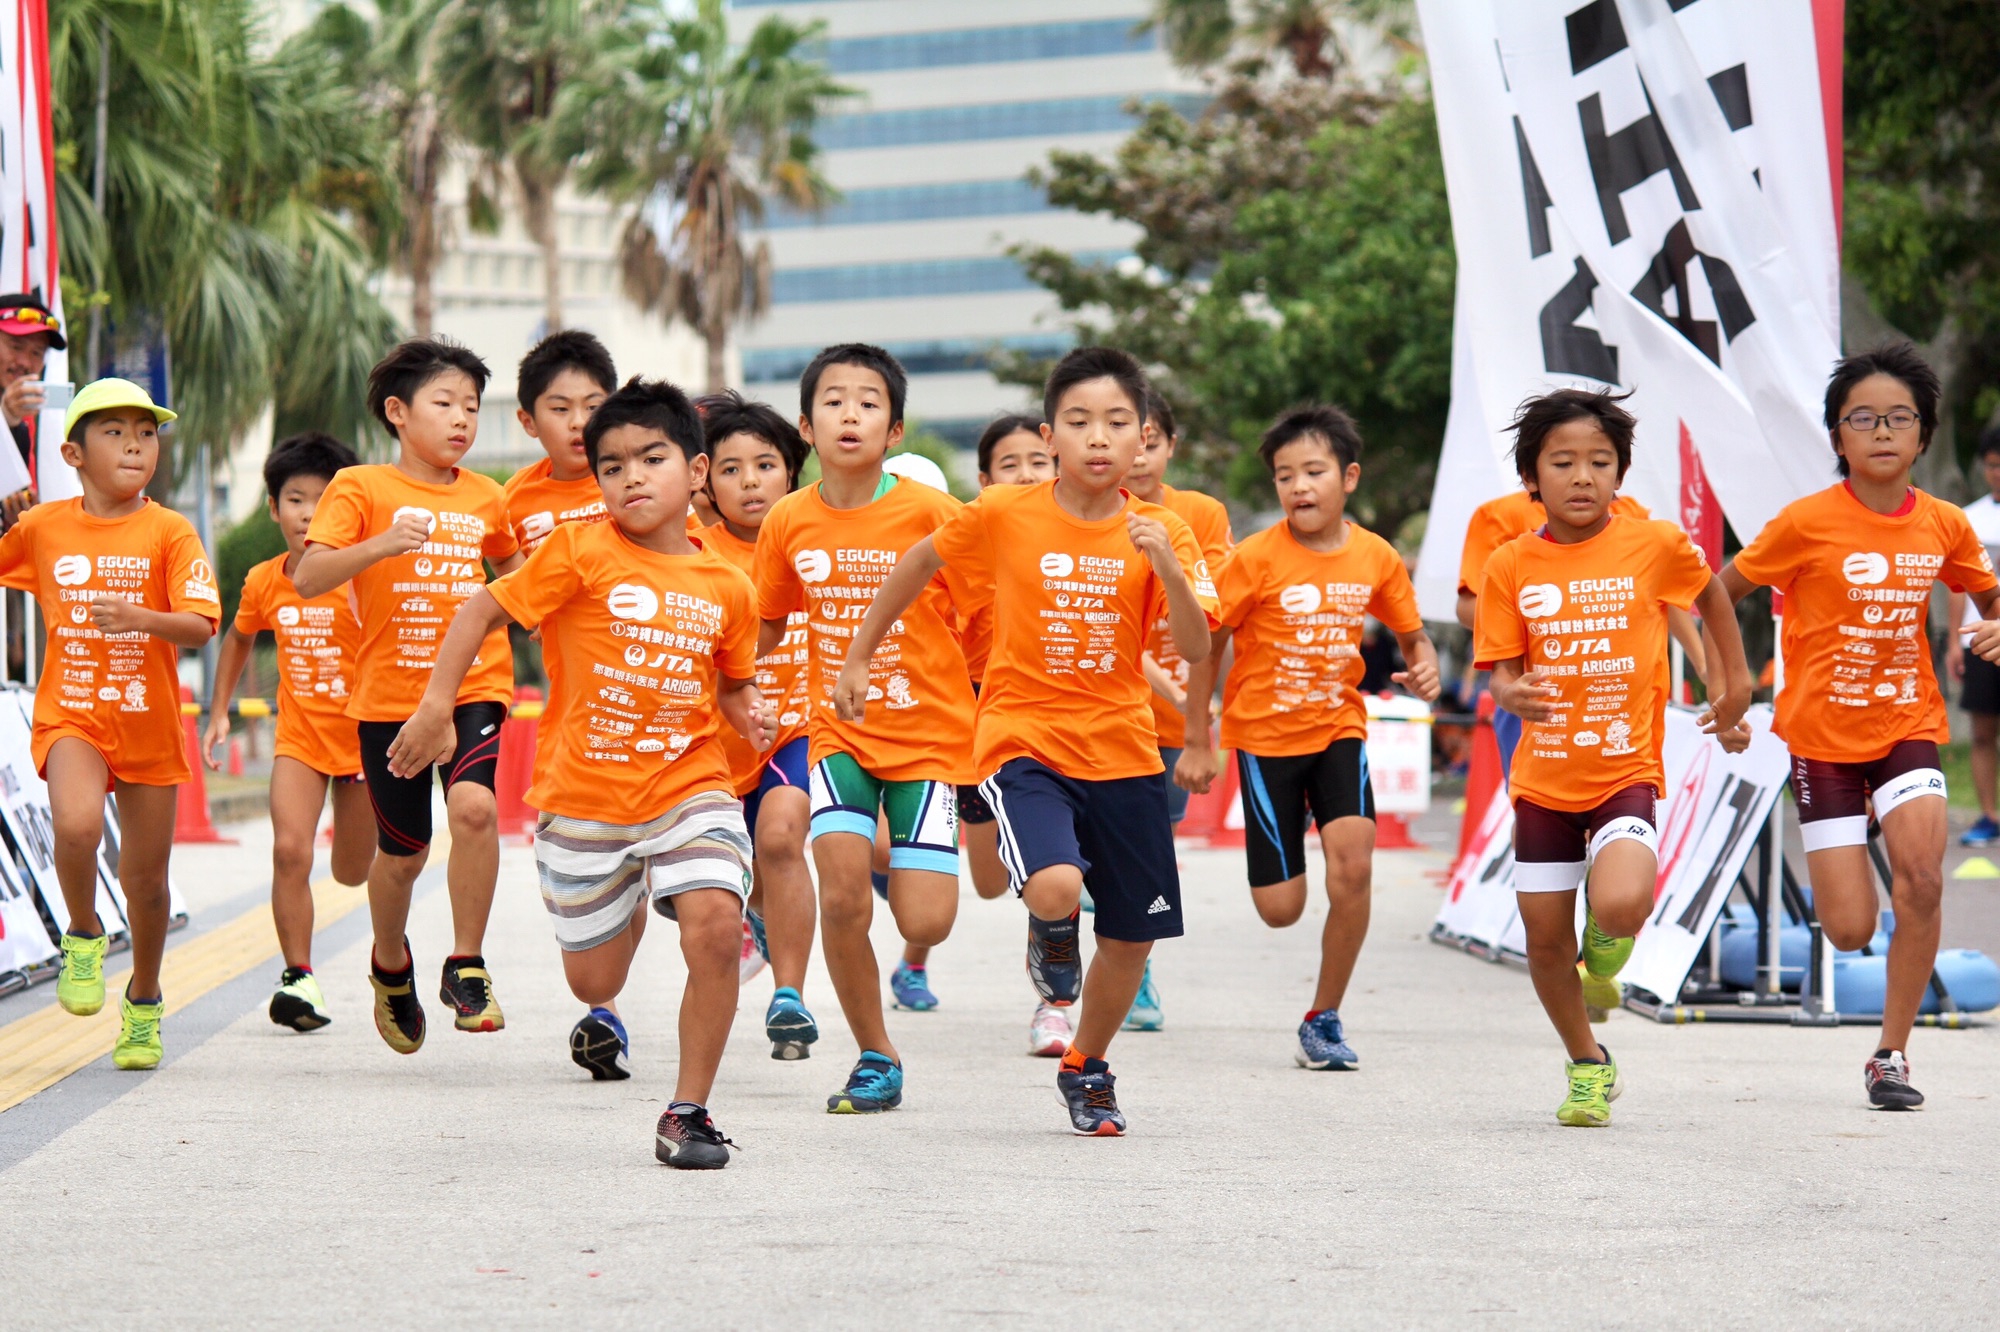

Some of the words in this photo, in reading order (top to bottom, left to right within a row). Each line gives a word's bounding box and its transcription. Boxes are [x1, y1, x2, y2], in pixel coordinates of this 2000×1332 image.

[560, 502, 608, 520] EGUCH
[442, 524, 483, 537] HOLDING
[453, 533, 481, 545] GROU
[97, 556, 150, 570] EGUCHI
[836, 549, 897, 564] EGUCHI
[1079, 556, 1125, 569] EGUCHI
[1895, 554, 1945, 568] EGUCH
[97, 569, 150, 579] HOLDINGS
[435, 562, 474, 578] JTA
[1079, 565, 1124, 577] HOLDINGS
[1896, 568, 1939, 577] HOLDING
[106, 579, 142, 588] GROUP
[848, 574, 888, 583] GROUP
[1086, 574, 1117, 583] GROUP
[813, 585, 880, 599] 沖縄製粉株式会
[1326, 583, 1373, 596] EGUCHI
[1569, 576, 1635, 595] EGUCHI
[1072, 596, 1104, 608] JTA
[1570, 591, 1635, 604] HOLDINGS
[665, 591, 723, 620] EGUCHI
[1582, 603, 1625, 614] GROUP
[665, 607, 721, 630] HOLDINGS
[1084, 612, 1120, 622] ARIGHTS
[1884, 606, 1917, 622] JTA
[676, 620, 716, 637] GROUP
[1316, 628, 1348, 641] JTA
[302, 637, 327, 648] JTA
[1563, 638, 1611, 657] JTA
[647, 653, 694, 674] JTA
[1582, 656, 1635, 674] ARIGHTS
[592, 662, 660, 690] 那覇眼科医院
[660, 677, 702, 695] ARIGHTS
[590, 715, 635, 734] タツキ歯科
[1147, 904, 1171, 914] adidas
